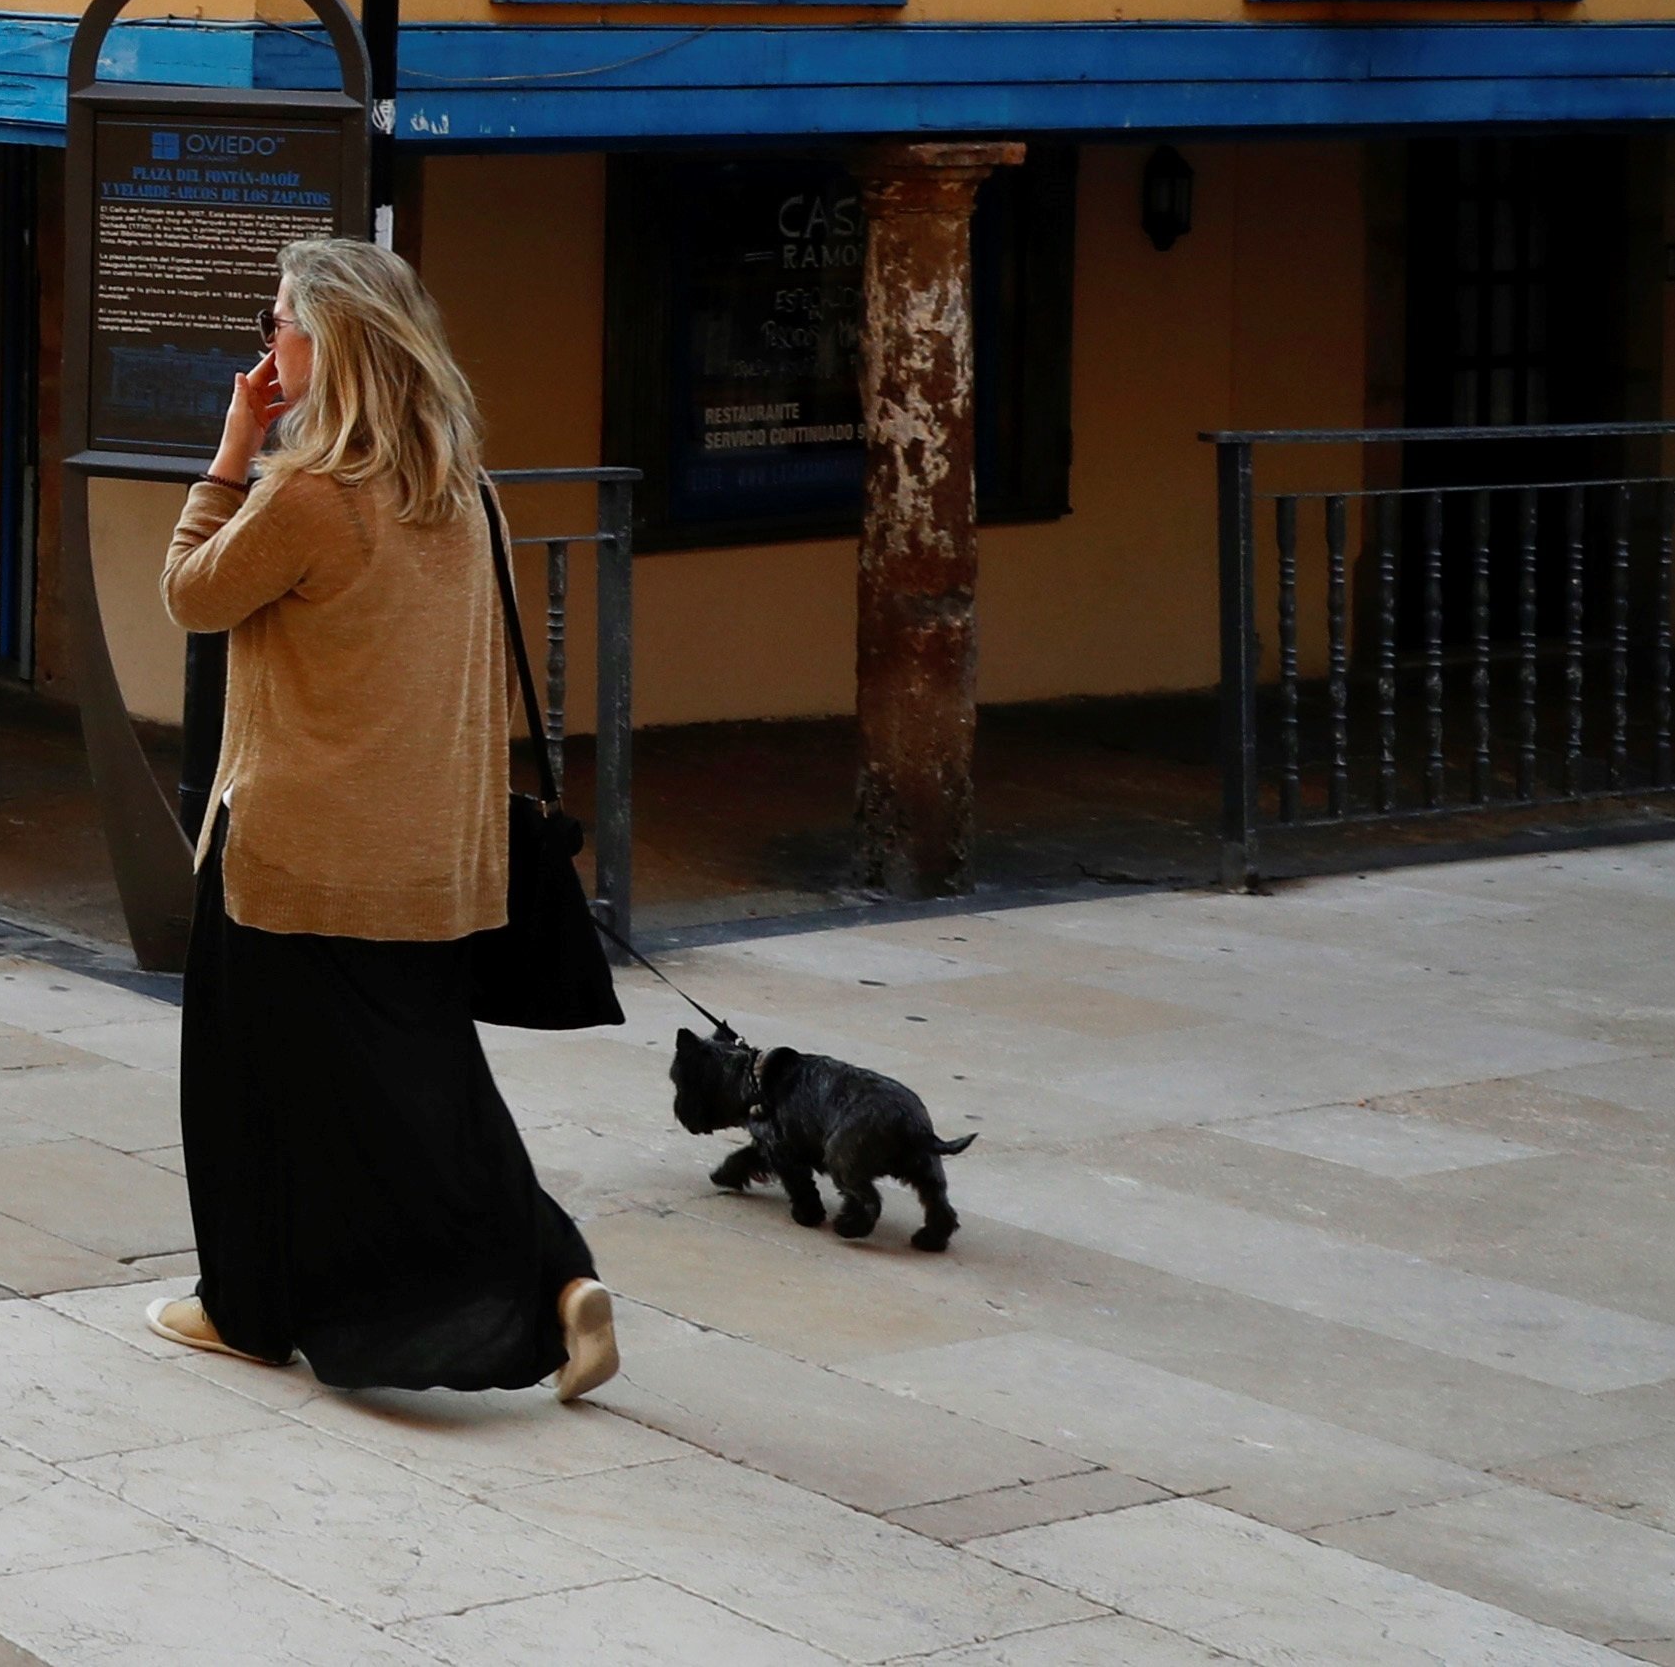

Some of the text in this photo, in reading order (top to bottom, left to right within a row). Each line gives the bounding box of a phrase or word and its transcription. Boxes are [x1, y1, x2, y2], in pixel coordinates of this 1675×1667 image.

[186, 133, 276, 156] OVIEDO
[132, 166, 173, 182] PLAZA
[176, 169, 199, 183] DEL
[101, 182, 331, 206] Y VELARDE-ARCOS DE LOS ZAPATOS
[778, 193, 862, 239] CAS
[782, 243, 862, 269] RAMO
[704, 402, 800, 426] RESTAURANTE
[704, 428, 766, 450] SERVICIO
[769, 422, 854, 445] CONTINUADO
